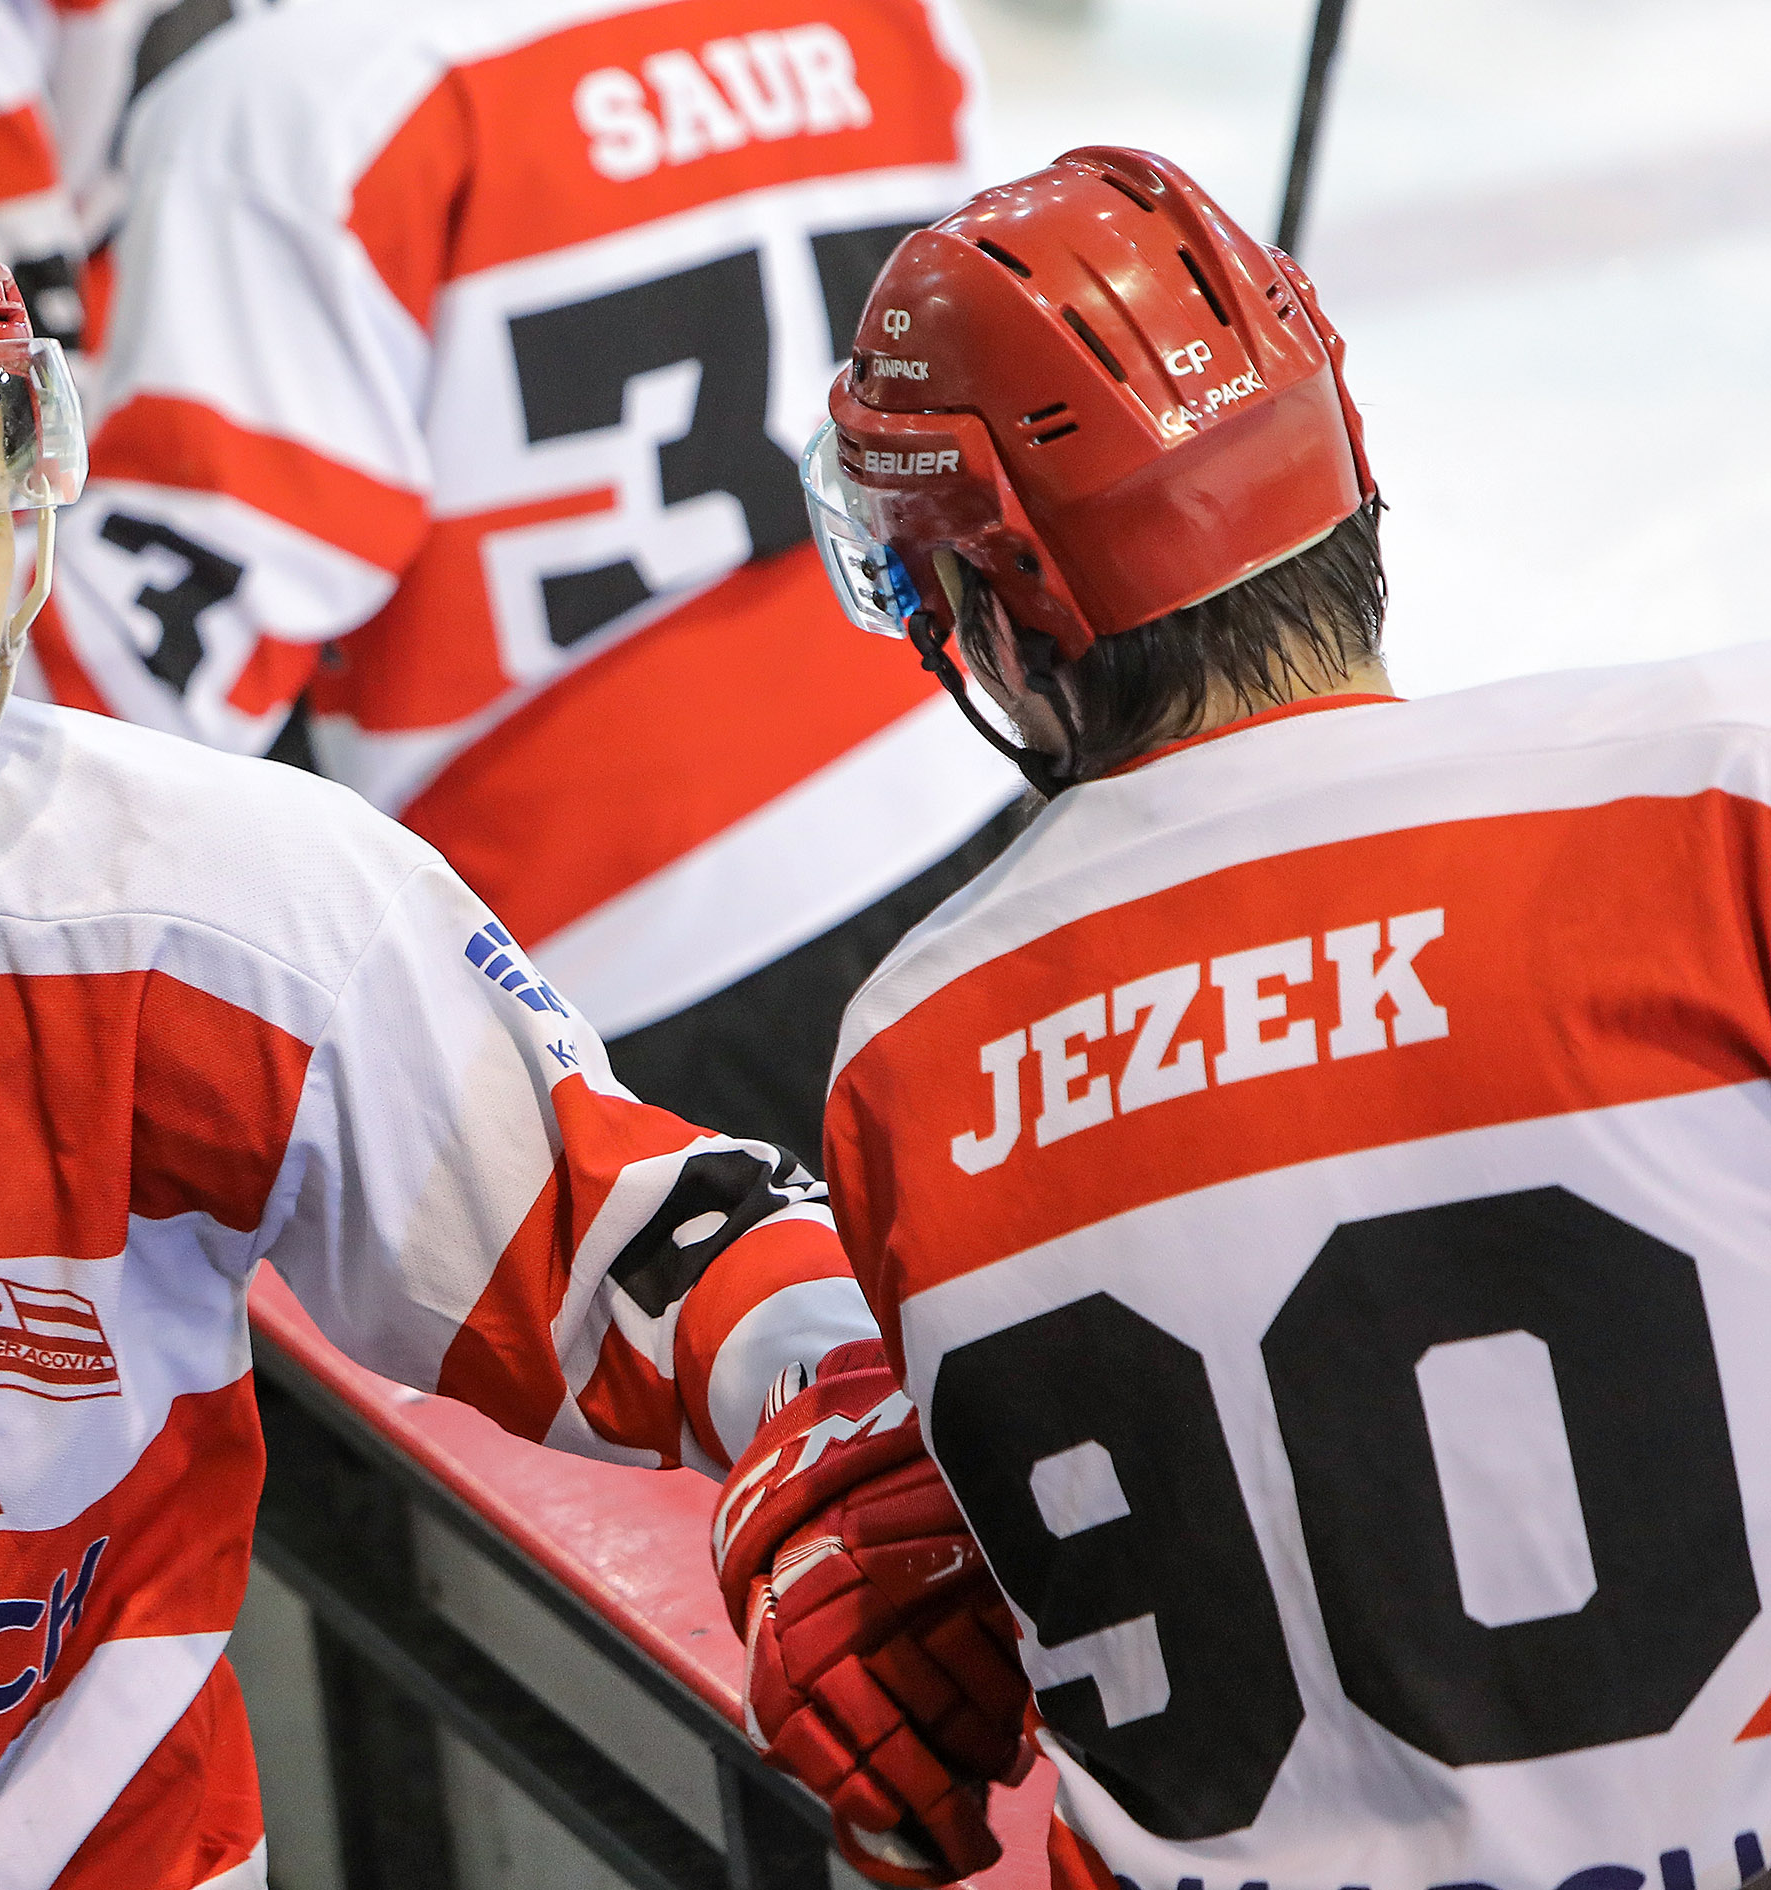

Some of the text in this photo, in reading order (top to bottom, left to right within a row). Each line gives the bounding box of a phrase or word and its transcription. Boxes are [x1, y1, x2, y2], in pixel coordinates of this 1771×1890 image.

[575, 24, 871, 180] SAUR
[873, 358, 930, 381] CANPACK
[865, 450, 960, 476] BAUER
[951, 907, 1450, 1176] JEZEK
[932, 1185, 1763, 1842] 90
